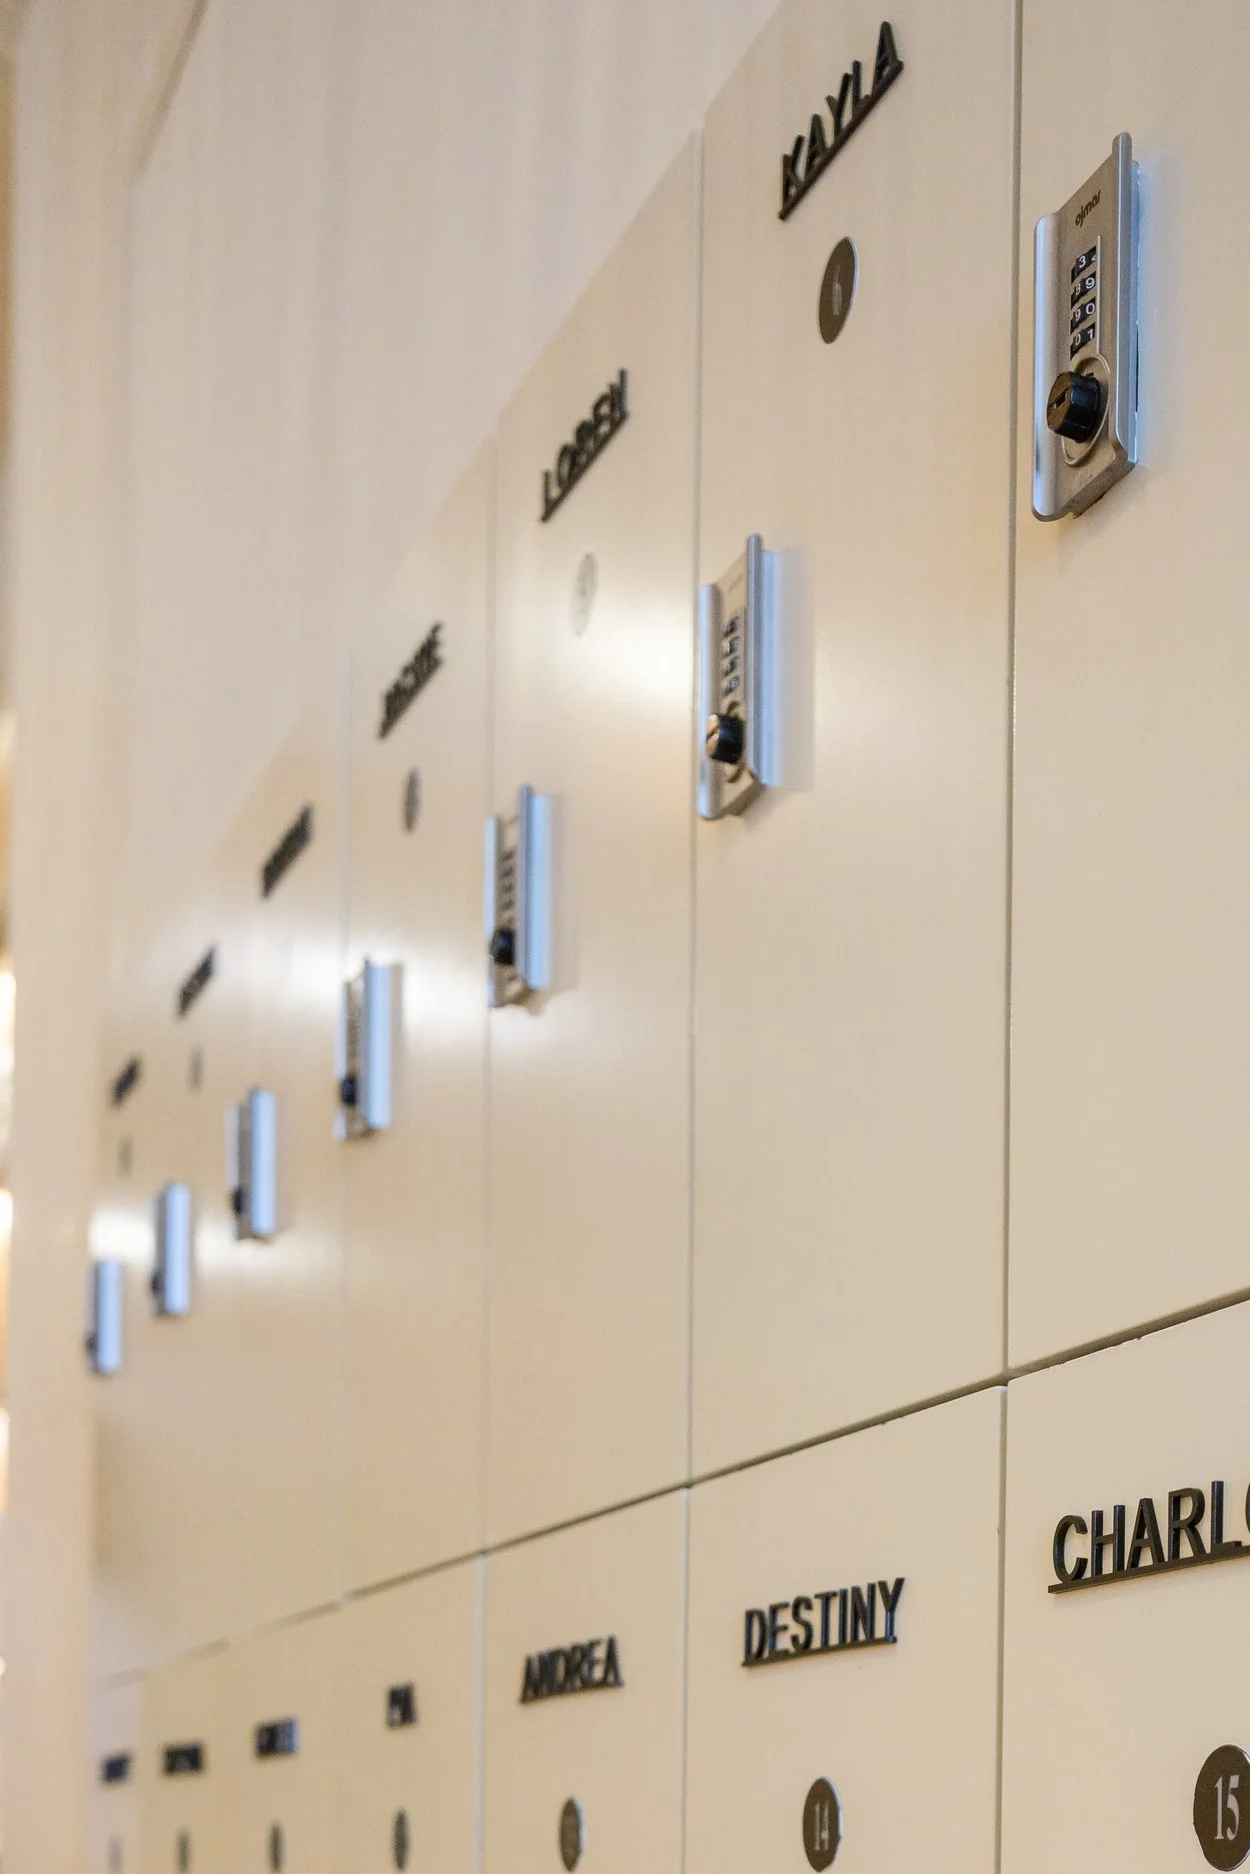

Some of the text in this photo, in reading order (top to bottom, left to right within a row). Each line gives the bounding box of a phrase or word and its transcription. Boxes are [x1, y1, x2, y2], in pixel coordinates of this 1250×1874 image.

[778, 20, 904, 220] KAYLA
[741, 1577, 905, 1668] DESTINY
[520, 1635, 624, 1706] ANDREA
[814, 1801, 829, 1851] 14
[1214, 1774, 1240, 1841] 15
